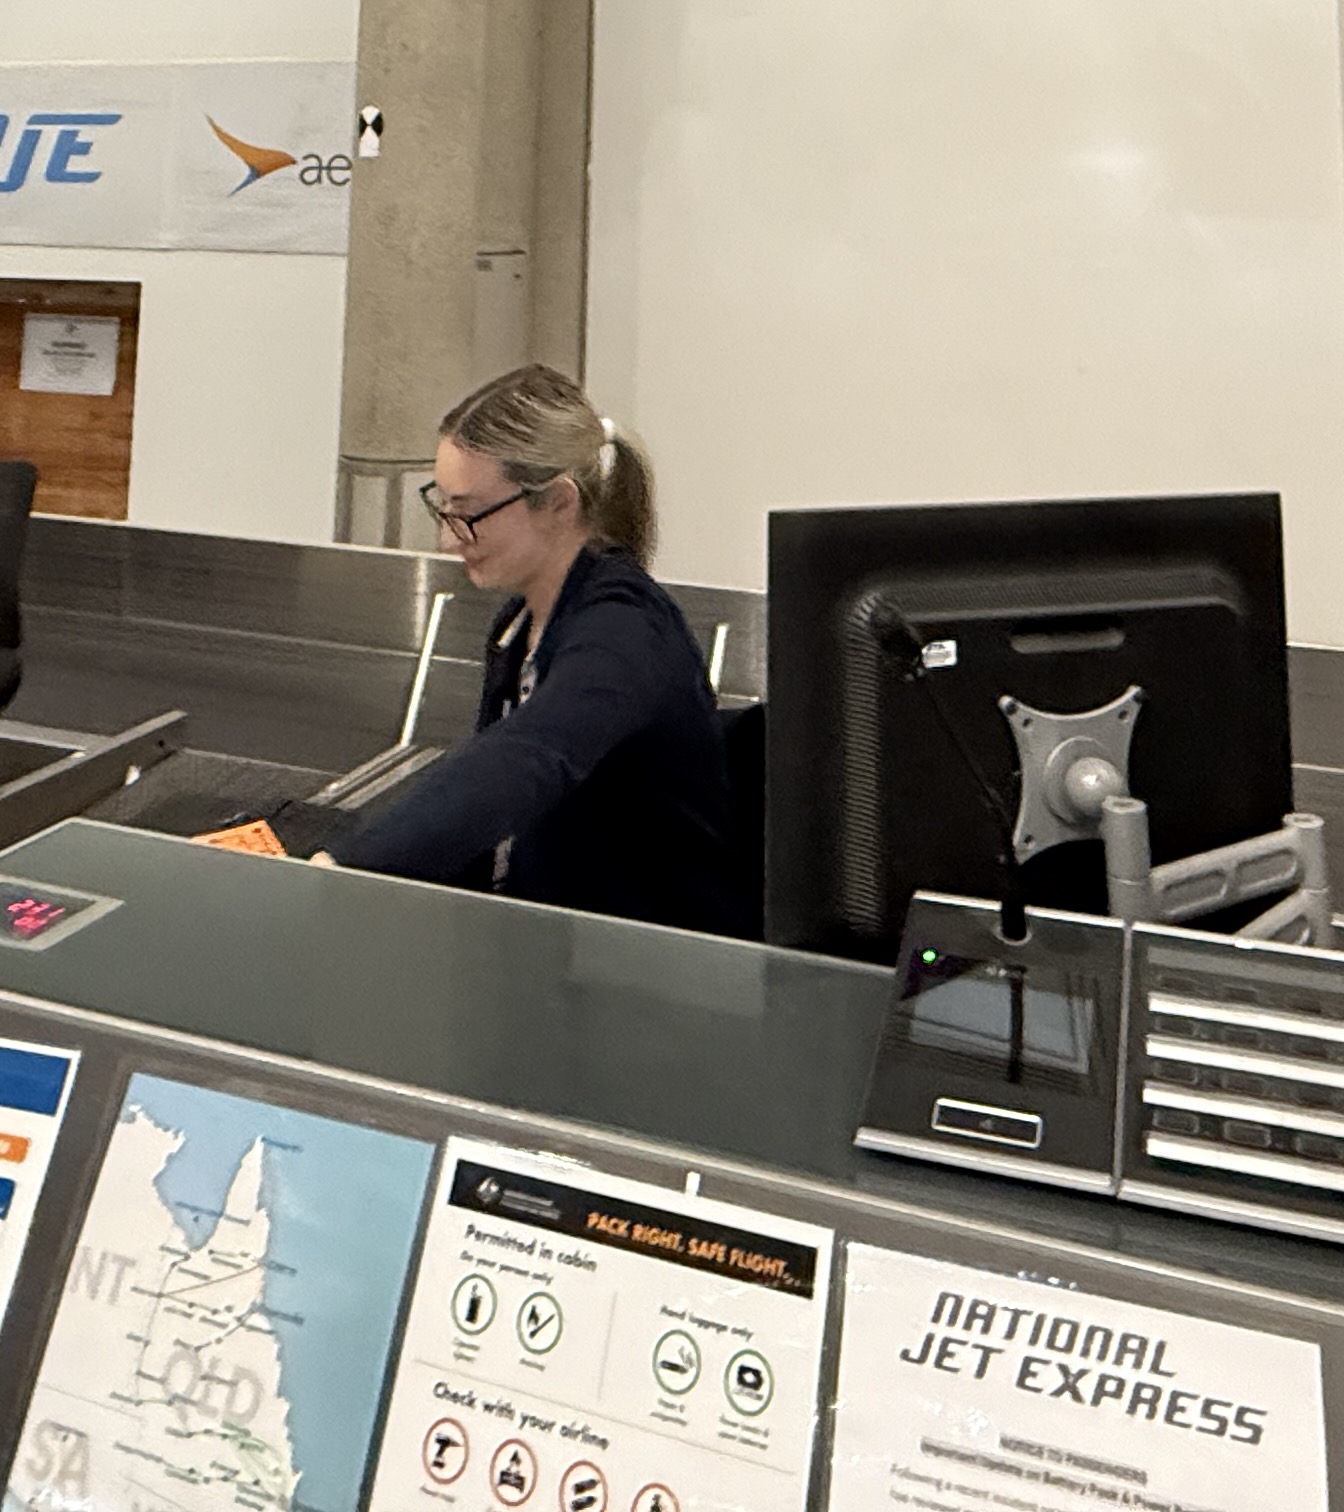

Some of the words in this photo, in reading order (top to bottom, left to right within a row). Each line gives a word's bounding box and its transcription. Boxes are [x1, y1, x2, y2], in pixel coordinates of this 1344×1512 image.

[465, 1223, 537, 1255] Permitted
[539, 1240, 554, 1261] in
[556, 1249, 598, 1273] cabin
[587, 1211, 631, 1239] PACK
[688, 1236, 727, 1263] SAFE
[69, 1245, 137, 1306] NT
[930, 1291, 1177, 1378] NATIONAL
[433, 1381, 476, 1409] Check
[481, 1395, 516, 1420] with
[518, 1411, 557, 1431] your
[558, 1420, 610, 1452] airline
[899, 1332, 1005, 1381] JET
[1015, 1355, 1268, 1447] EXPRESS
[26, 1418, 89, 1499] SA
